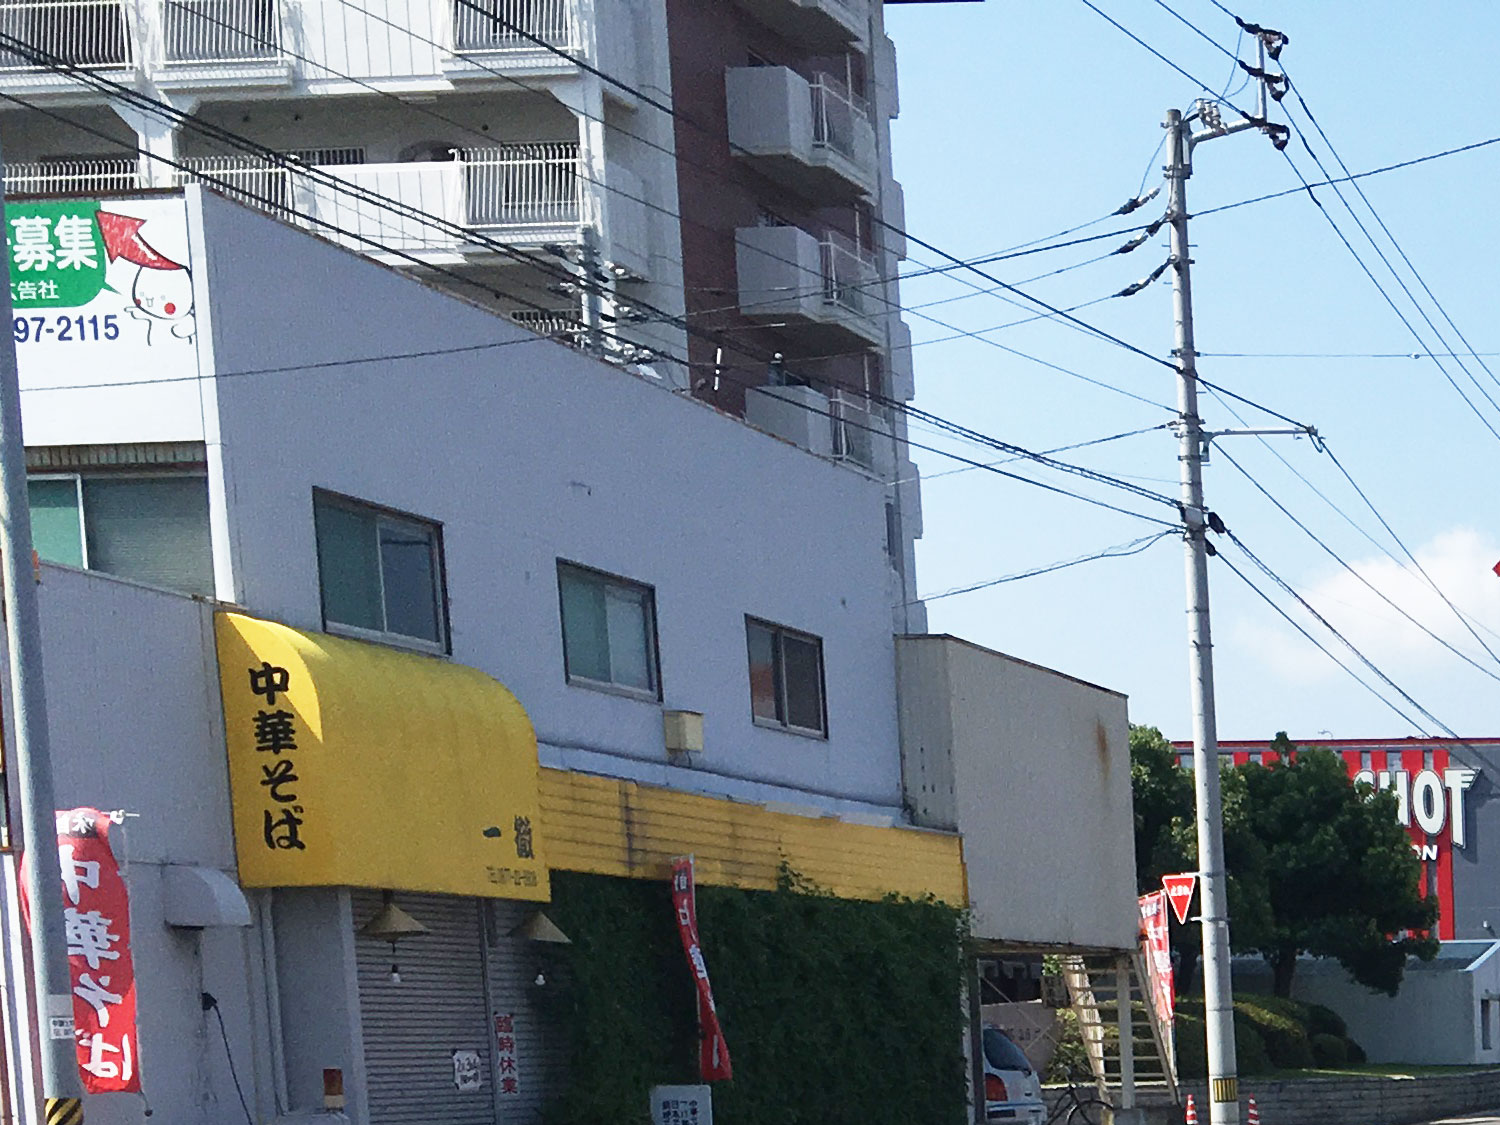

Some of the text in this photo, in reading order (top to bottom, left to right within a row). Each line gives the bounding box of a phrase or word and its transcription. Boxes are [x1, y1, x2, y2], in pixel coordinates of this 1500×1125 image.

[7, 213, 100, 273] 募集
[14, 314, 120, 344] 97-2115
[247, 661, 307, 851] 中華そば
[495, 1015, 519, 1095] 臨時休業
